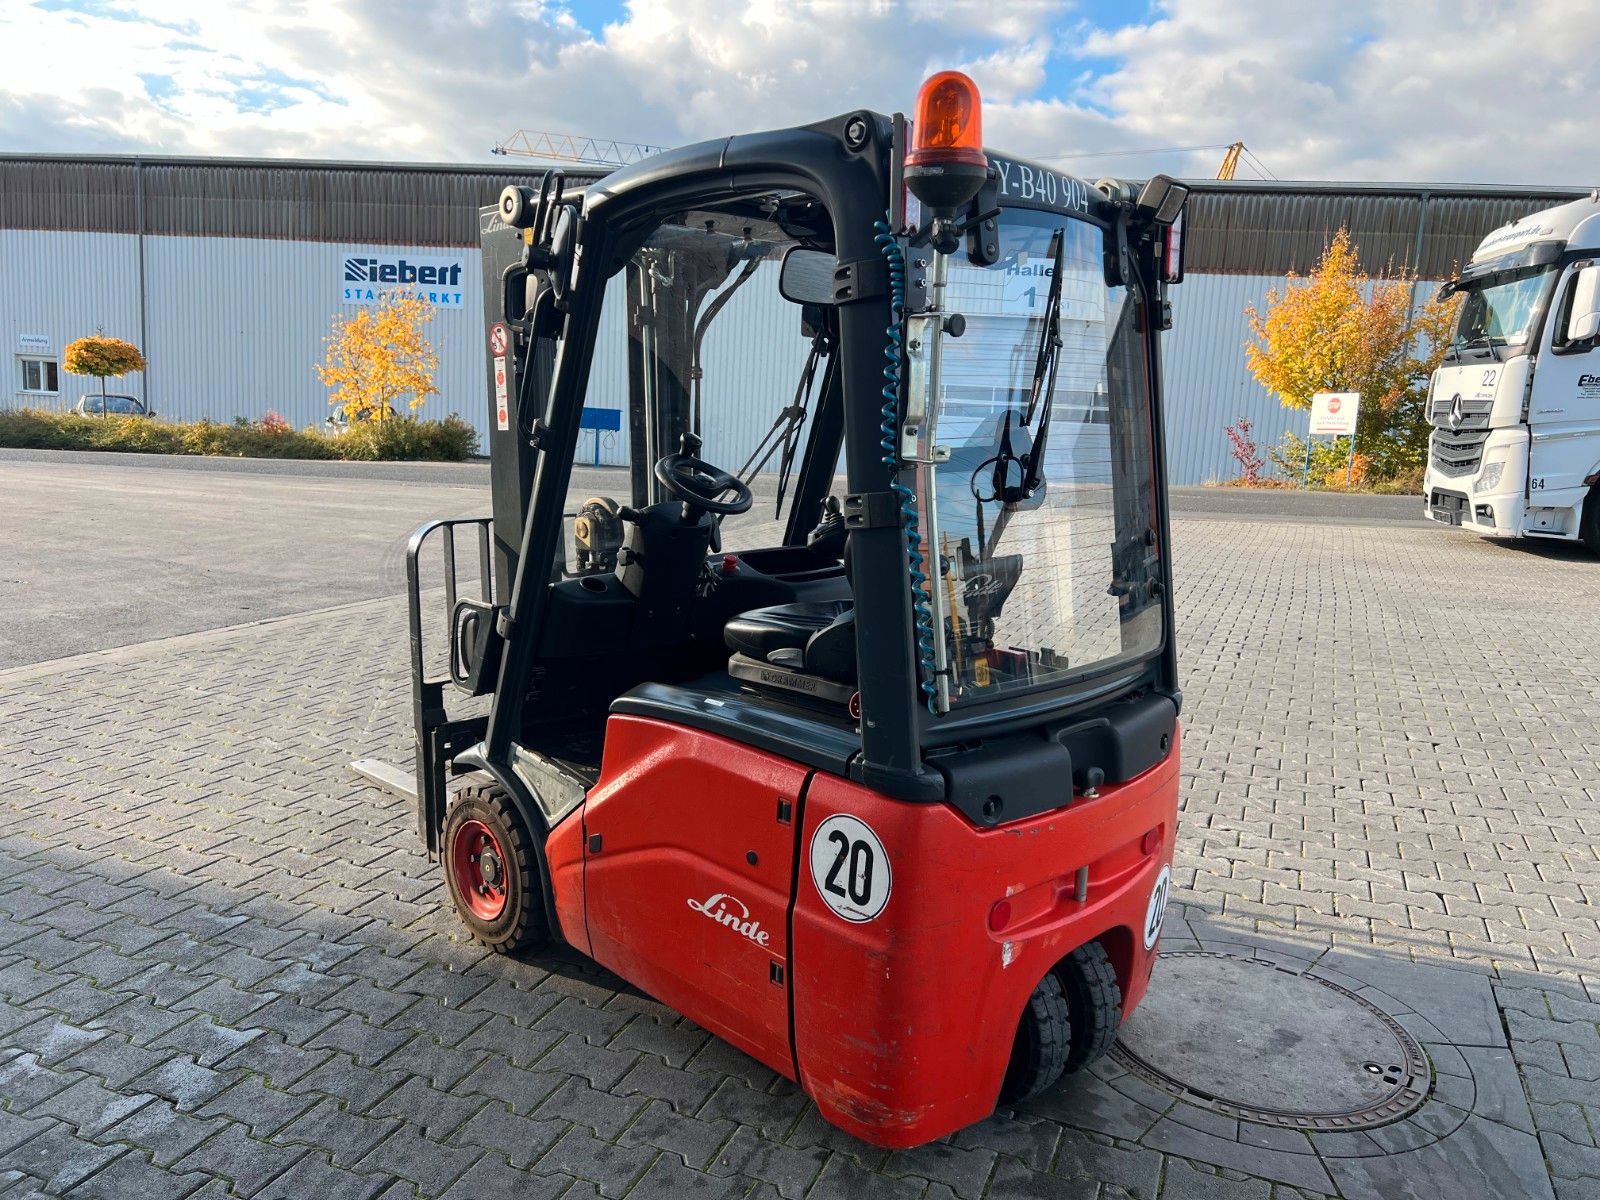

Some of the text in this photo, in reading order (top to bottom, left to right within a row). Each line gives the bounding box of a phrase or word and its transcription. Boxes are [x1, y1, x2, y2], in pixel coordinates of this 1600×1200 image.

[1062, 176, 1088, 214] 904
[481, 213, 514, 234] Lin
[344, 258, 462, 286] Siebert
[1007, 263, 1054, 277] Halle
[1023, 286, 1036, 308] 1
[1482, 369, 1497, 387] 22
[1531, 478, 1545, 490] 64
[824, 829, 874, 907] 20
[687, 893, 770, 946] Linde
[1148, 876, 1168, 938] 20
